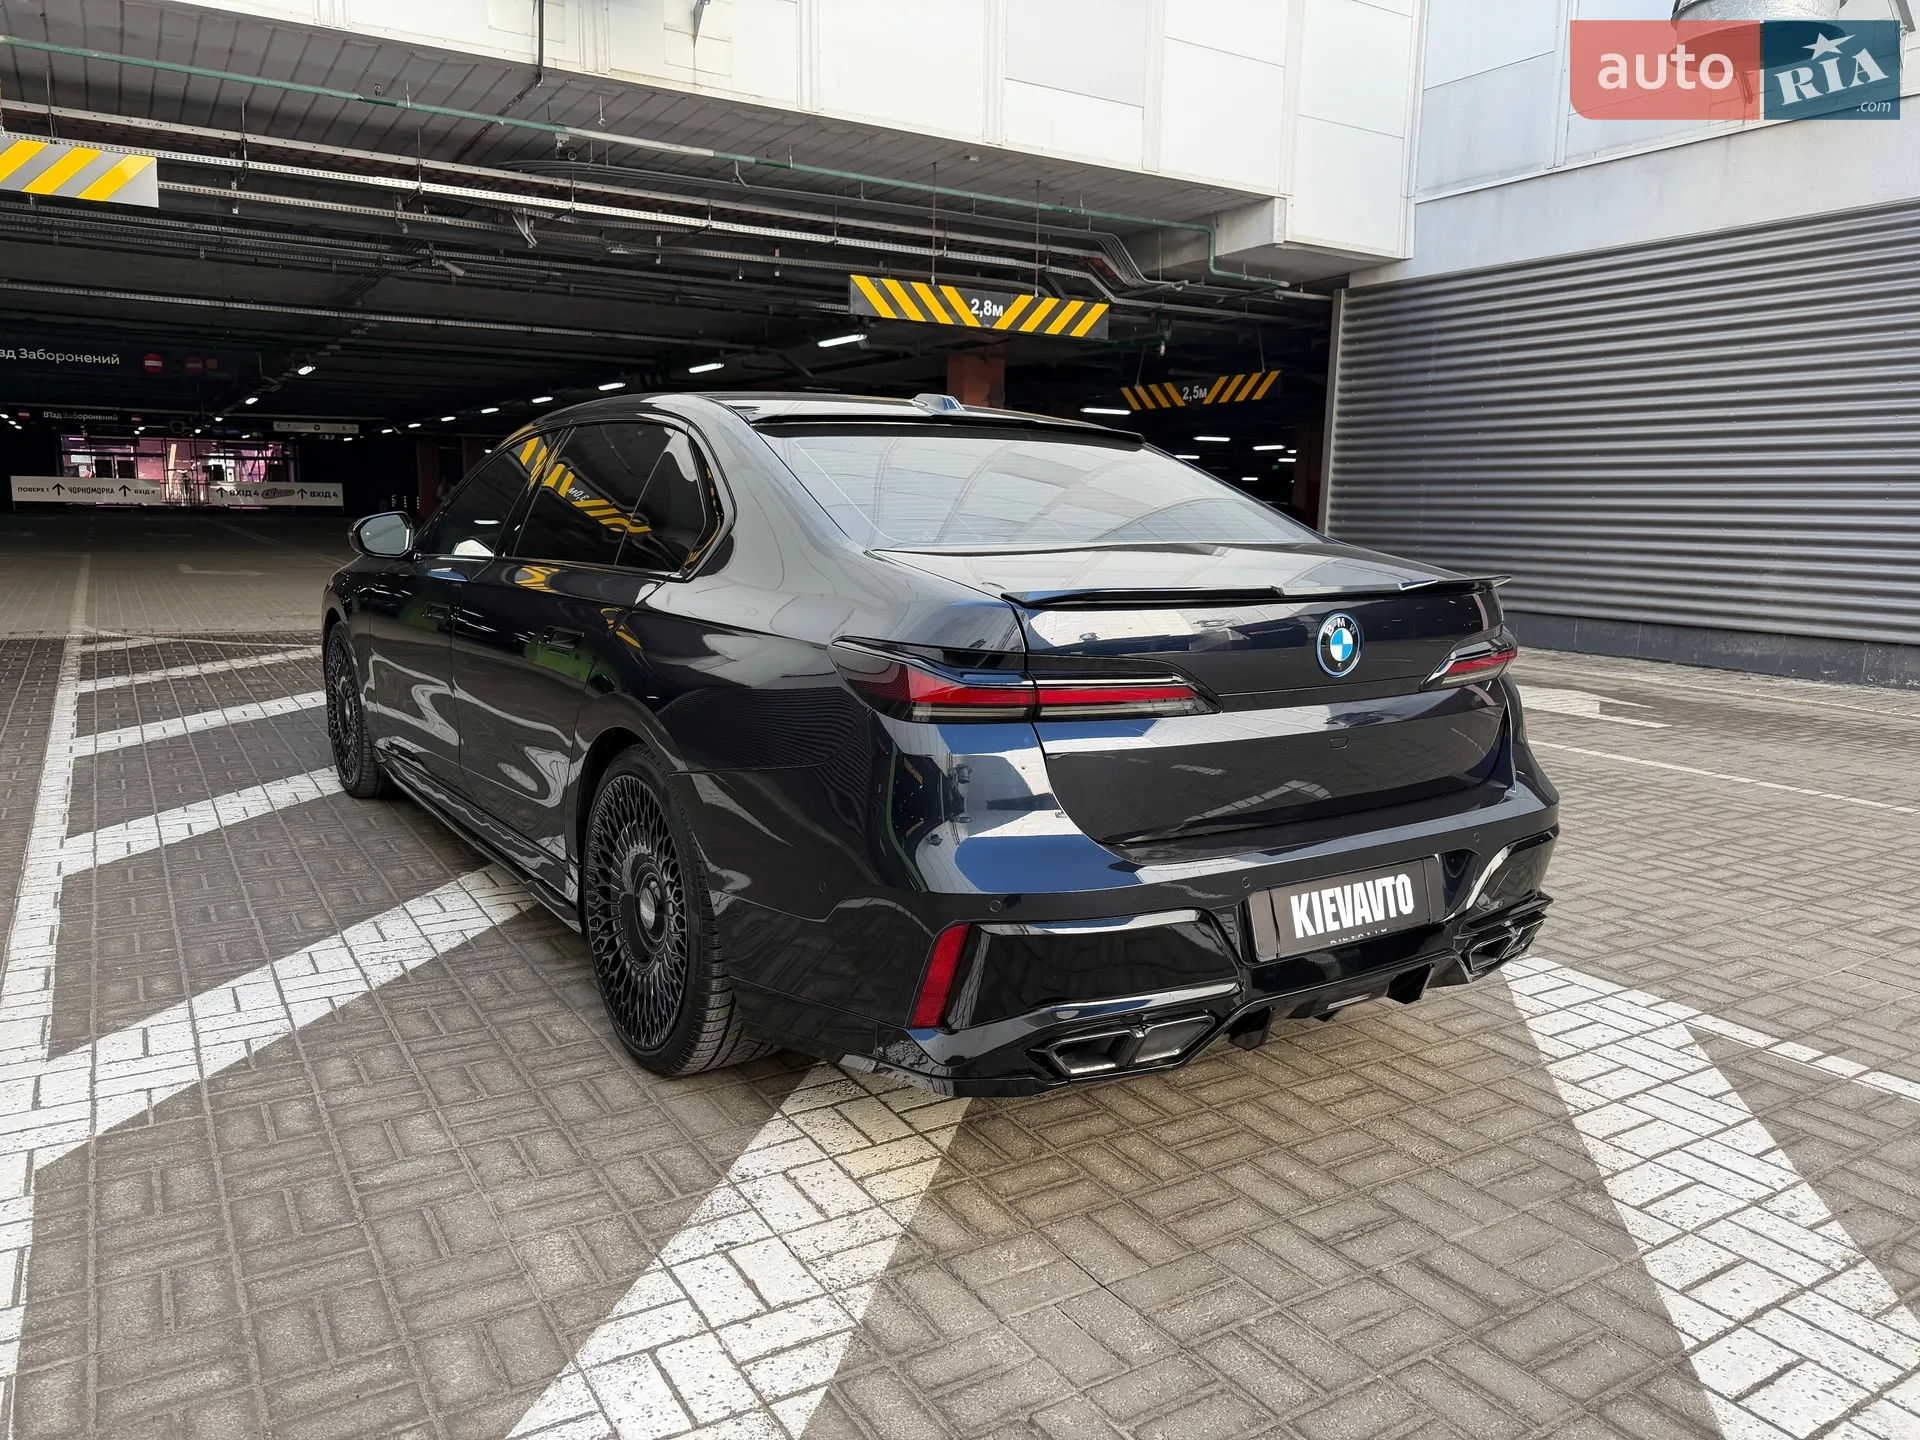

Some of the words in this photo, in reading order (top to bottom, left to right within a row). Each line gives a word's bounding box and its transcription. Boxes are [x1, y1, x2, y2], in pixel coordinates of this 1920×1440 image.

[18, 348, 120, 365] Заборонений
[62, 412, 118, 421] Заборонений
[67, 487, 115, 495] ЧОРНОМОРКА
[229, 489, 252, 498] ВХІД
[253, 489, 260, 497] 4
[309, 491, 332, 499] ВХІД
[1325, 617, 1357, 637] BMW
[1289, 873, 1415, 940] KIEVAVTO
